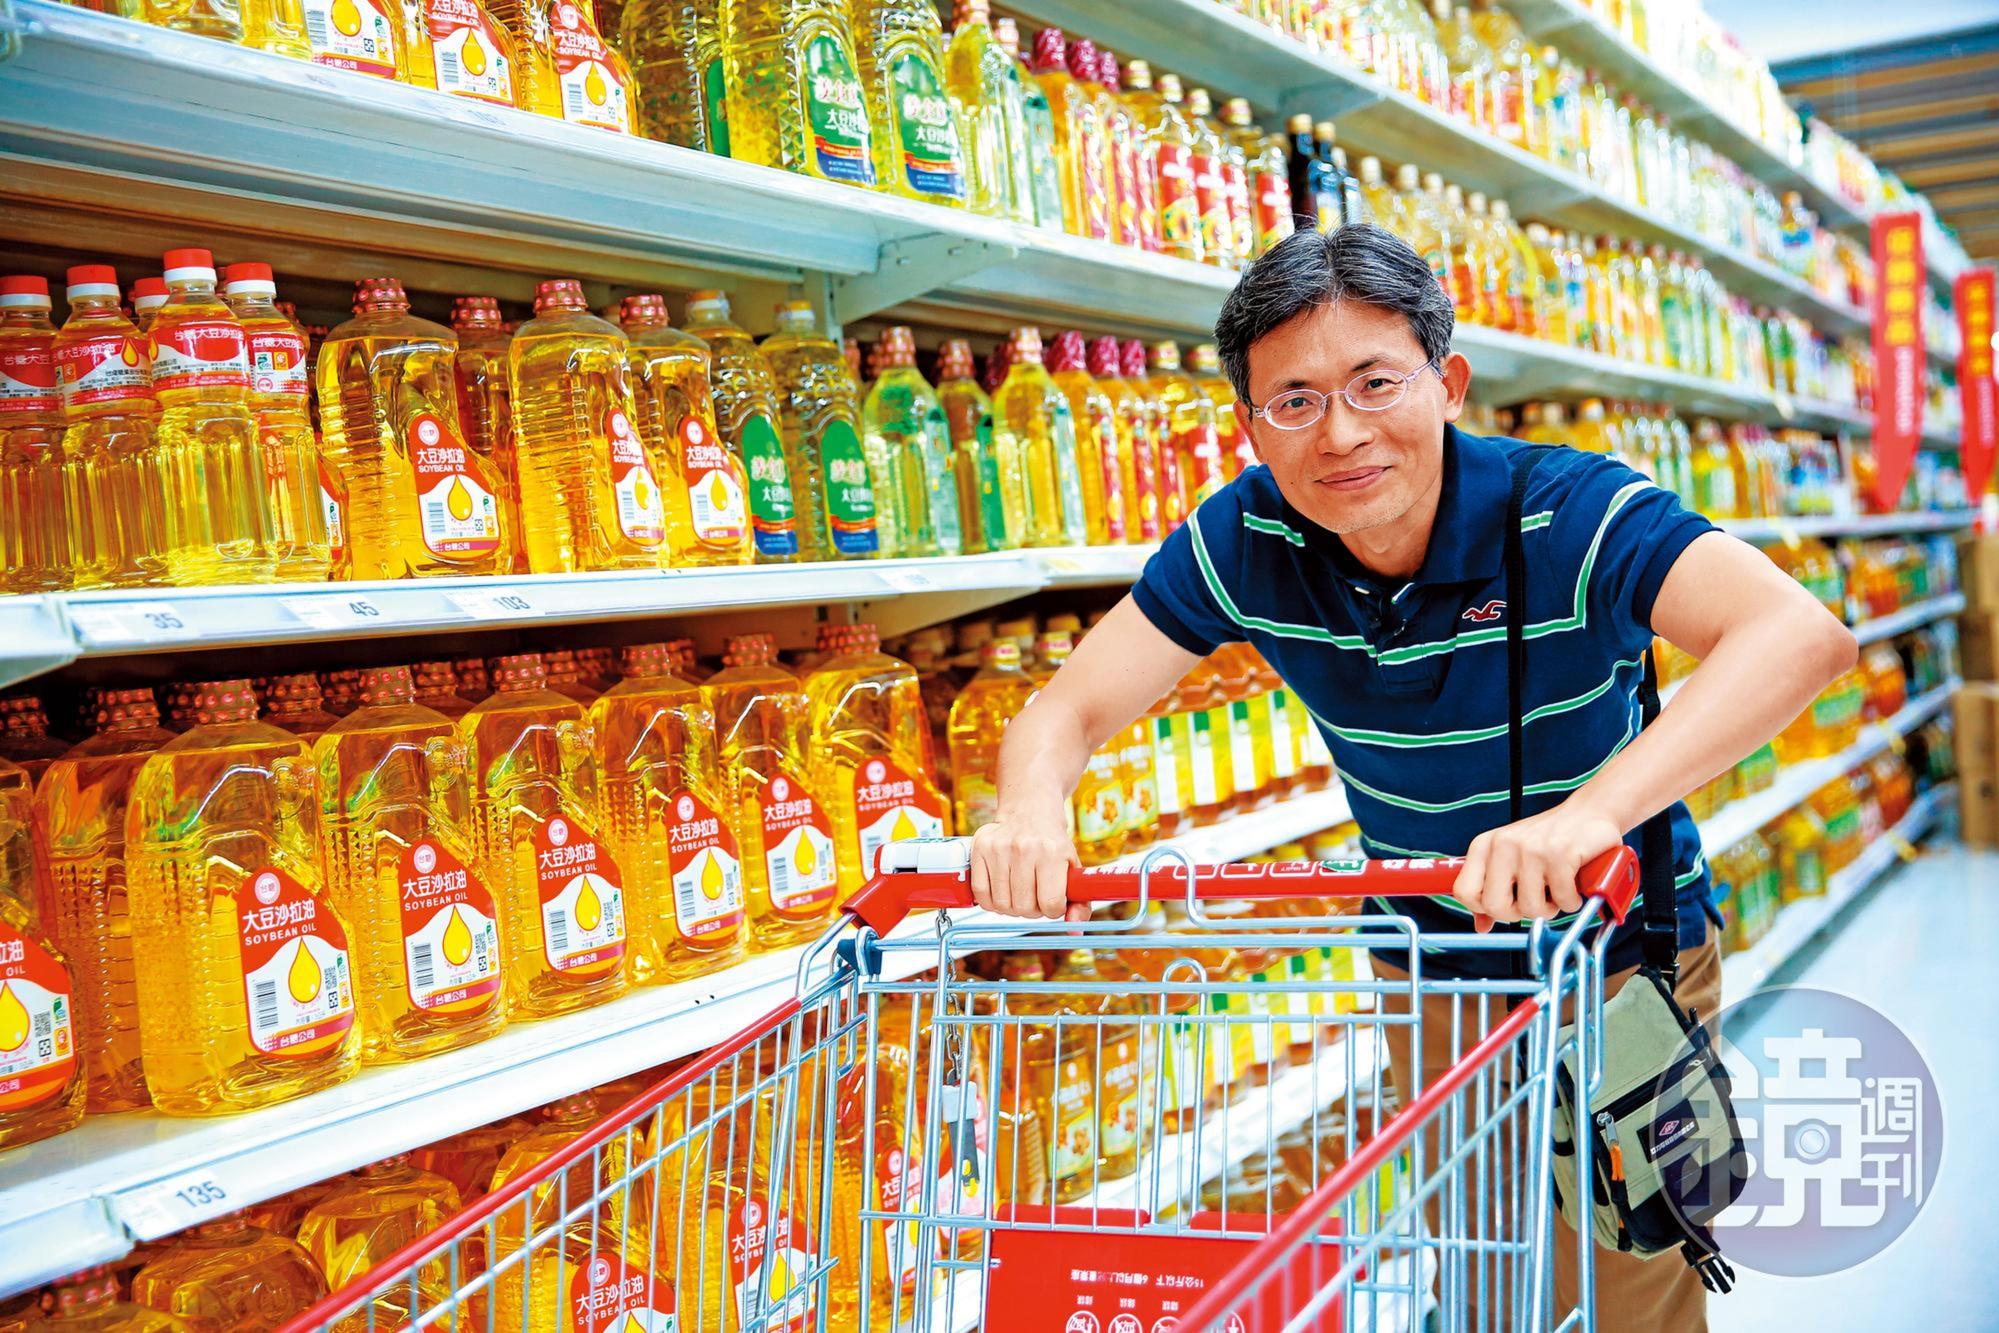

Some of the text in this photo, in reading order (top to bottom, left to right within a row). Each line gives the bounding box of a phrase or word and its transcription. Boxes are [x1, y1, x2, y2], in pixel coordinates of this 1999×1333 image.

[418, 464, 453, 473] SOYBEAN
[349, 600, 380, 618] 45
[497, 594, 531, 611] 103
[144, 612, 184, 630] 35
[669, 817, 719, 844] 大豆沙拉油
[765, 818, 801, 831] SOYBEAN
[671, 839, 707, 854] SOYBEAN
[539, 842, 596, 870] 大豆沙拉油
[541, 863, 597, 880] SOYBEAN OIL
[402, 868, 467, 900] 大豆沙拉油
[404, 892, 468, 911] SOYBEAN OIL
[242, 897, 316, 934] 大豆沙拉油
[244, 923, 317, 946] SOYBEAN OIL
[5, 965, 26, 977] OIL
[176, 1180, 227, 1208] 135
[630, 1296, 645, 1307] OIL
